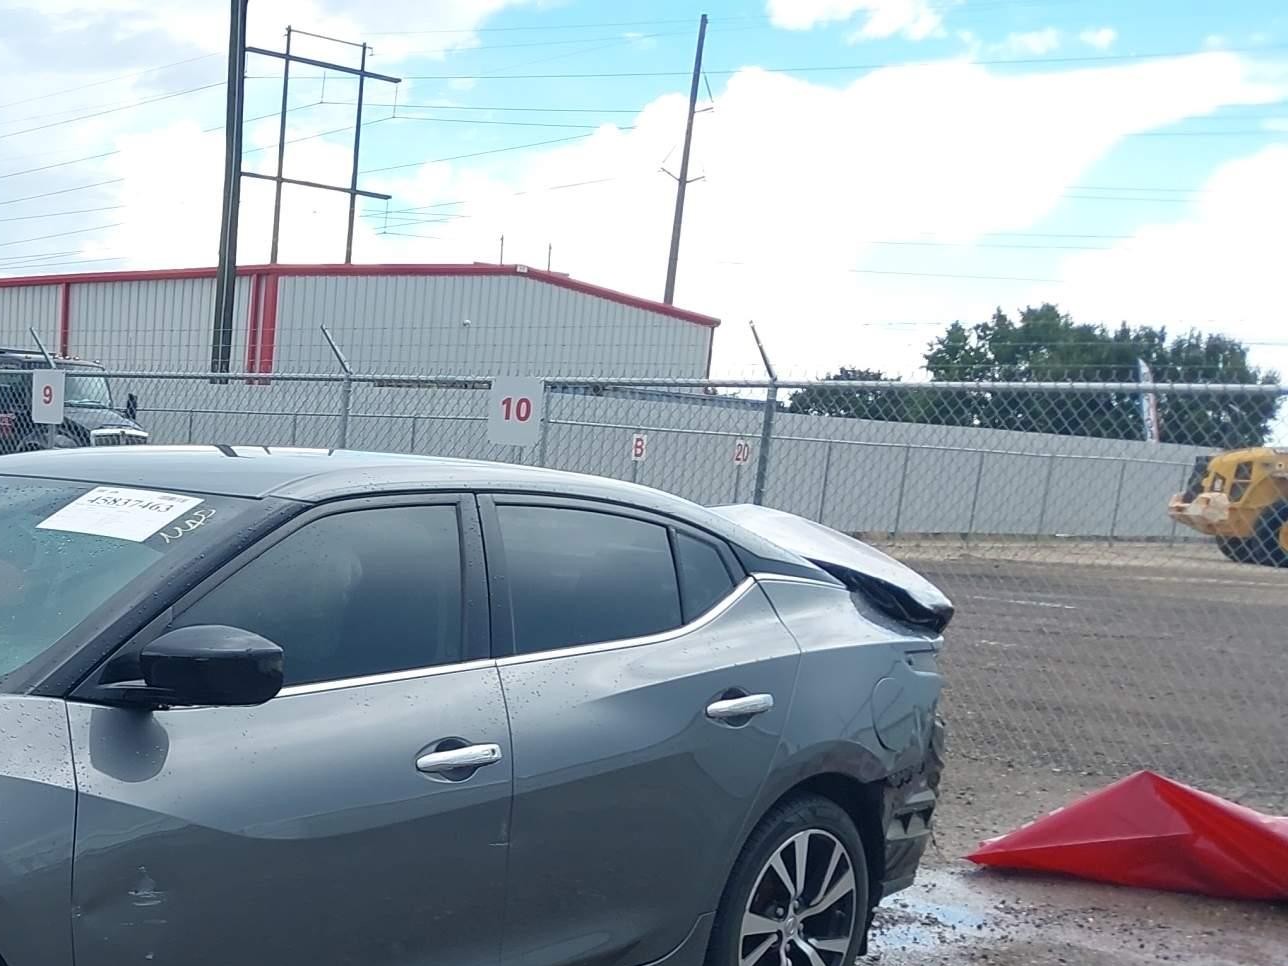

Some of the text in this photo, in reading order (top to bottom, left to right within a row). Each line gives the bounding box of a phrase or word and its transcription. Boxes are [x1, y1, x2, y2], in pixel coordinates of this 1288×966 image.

[42, 385, 53, 404] 9
[501, 397, 532, 422] 10
[633, 438, 644, 457] B
[735, 443, 749, 461] 20
[88, 495, 174, 513] 45837463
